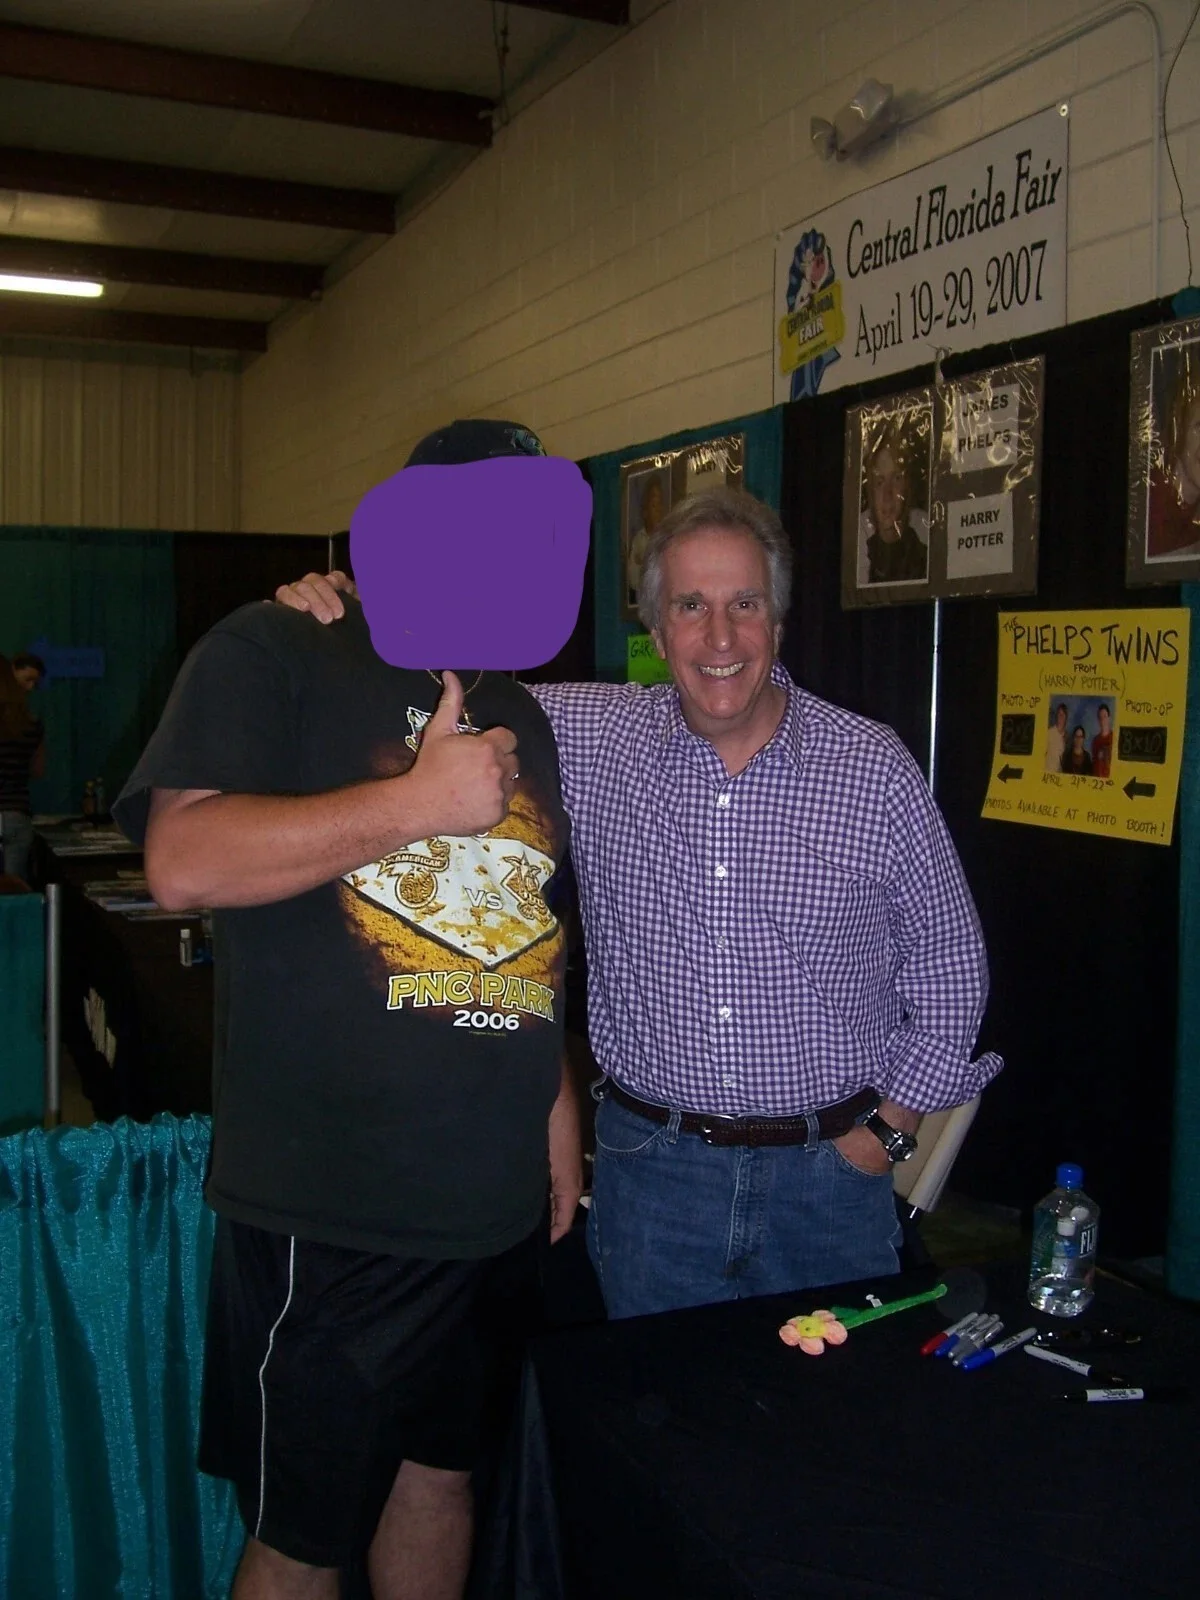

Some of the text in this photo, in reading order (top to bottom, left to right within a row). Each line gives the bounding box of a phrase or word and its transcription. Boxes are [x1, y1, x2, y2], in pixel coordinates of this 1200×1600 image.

[847, 149, 1062, 279] Central Florida Fair
[855, 292, 903, 365] April
[909, 266, 976, 337] 19-29,
[986, 239, 1047, 315] 2007
[798, 317, 825, 346] FAIR
[960, 509, 1000, 528] HARRY
[957, 532, 1004, 550] POTTER
[1002, 616, 1018, 633] THE
[1013, 624, 1180, 666] PHELPS TWINS
[1073, 663, 1097, 674] FROM
[1039, 668, 1126, 699] (HARRY POTTER)
[1041, 773, 1062, 788] APRIL
[984, 797, 1012, 811] PHOTOS
[1017, 800, 1058, 818] AVAILABLE
[1065, 809, 1080, 821] AT
[1087, 812, 1117, 826] PHOTO
[464, 887, 503, 910] VS
[386, 970, 554, 1023] PNC PARK
[453, 1009, 520, 1031] 2006
[1080, 1228, 1097, 1254] FIJ
